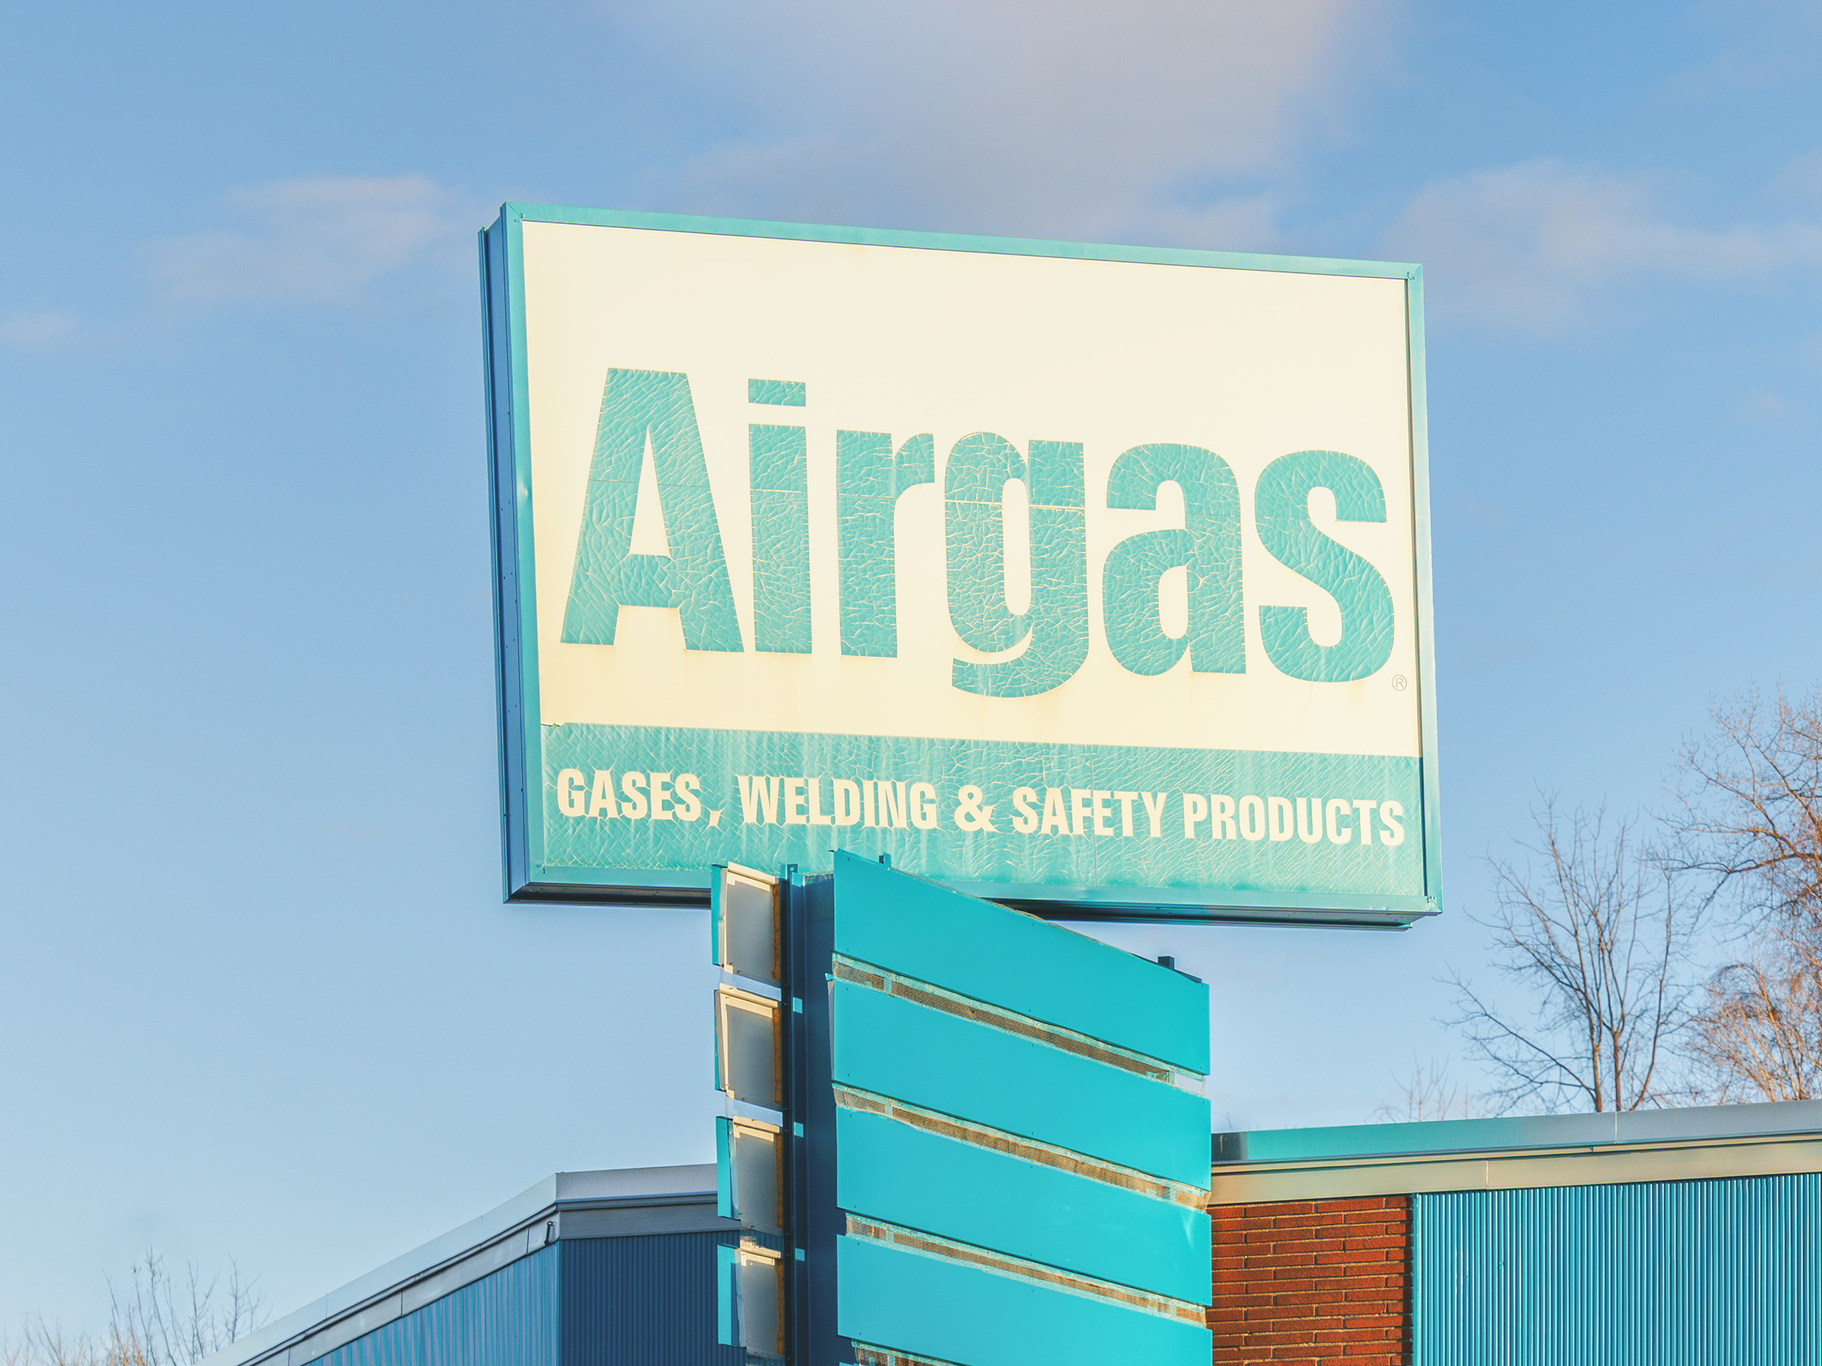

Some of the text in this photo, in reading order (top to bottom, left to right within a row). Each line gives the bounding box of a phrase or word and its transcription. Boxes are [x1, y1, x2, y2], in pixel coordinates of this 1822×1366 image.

[560, 367, 1394, 700] Airgas
[556, 768, 1405, 847] GASES, WELDING & SAFETY PRODUCTS
